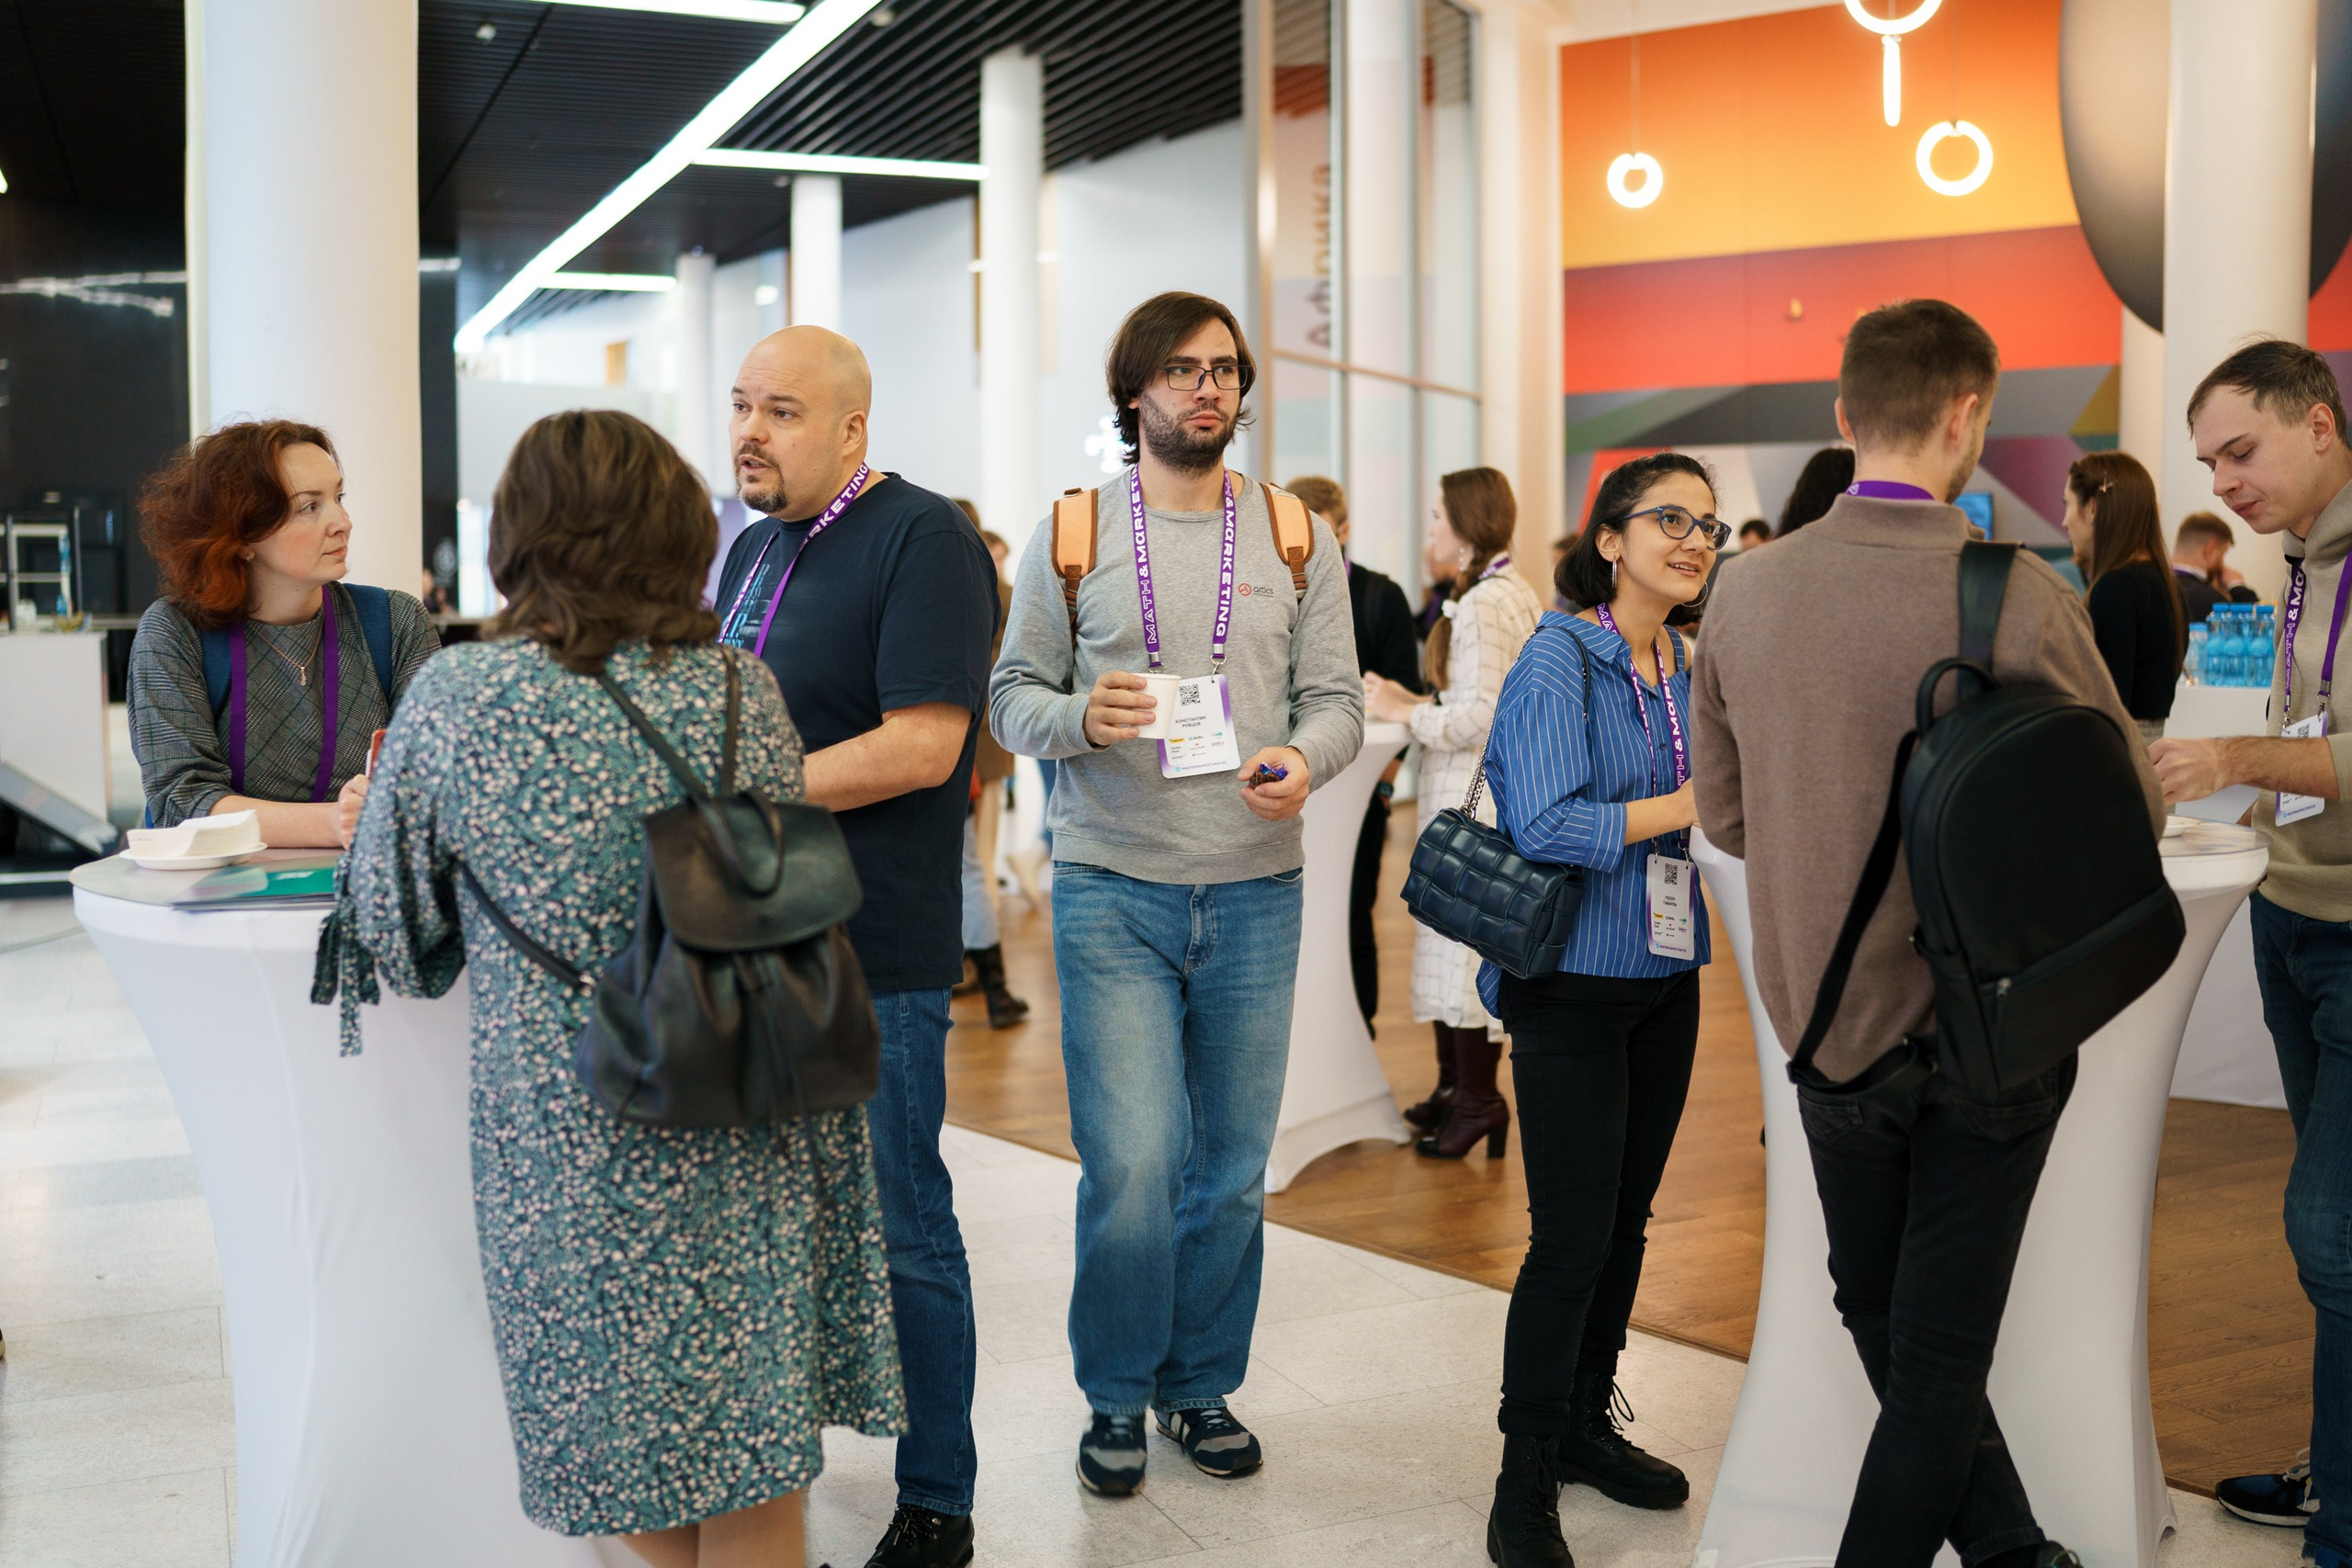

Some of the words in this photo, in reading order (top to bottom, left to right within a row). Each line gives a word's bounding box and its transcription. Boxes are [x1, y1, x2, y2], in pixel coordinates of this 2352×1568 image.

[806, 464, 868, 540] RKETING
[1226, 497, 1234, 508] &
[1138, 564, 1149, 578] &
[1253, 586, 1274, 594] artics
[1141, 580, 1157, 644] MATH
[1597, 603, 1617, 634] MA
[2288, 607, 2300, 622] &
[1675, 738, 1683, 752] &
[1677, 754, 1685, 787] TH
